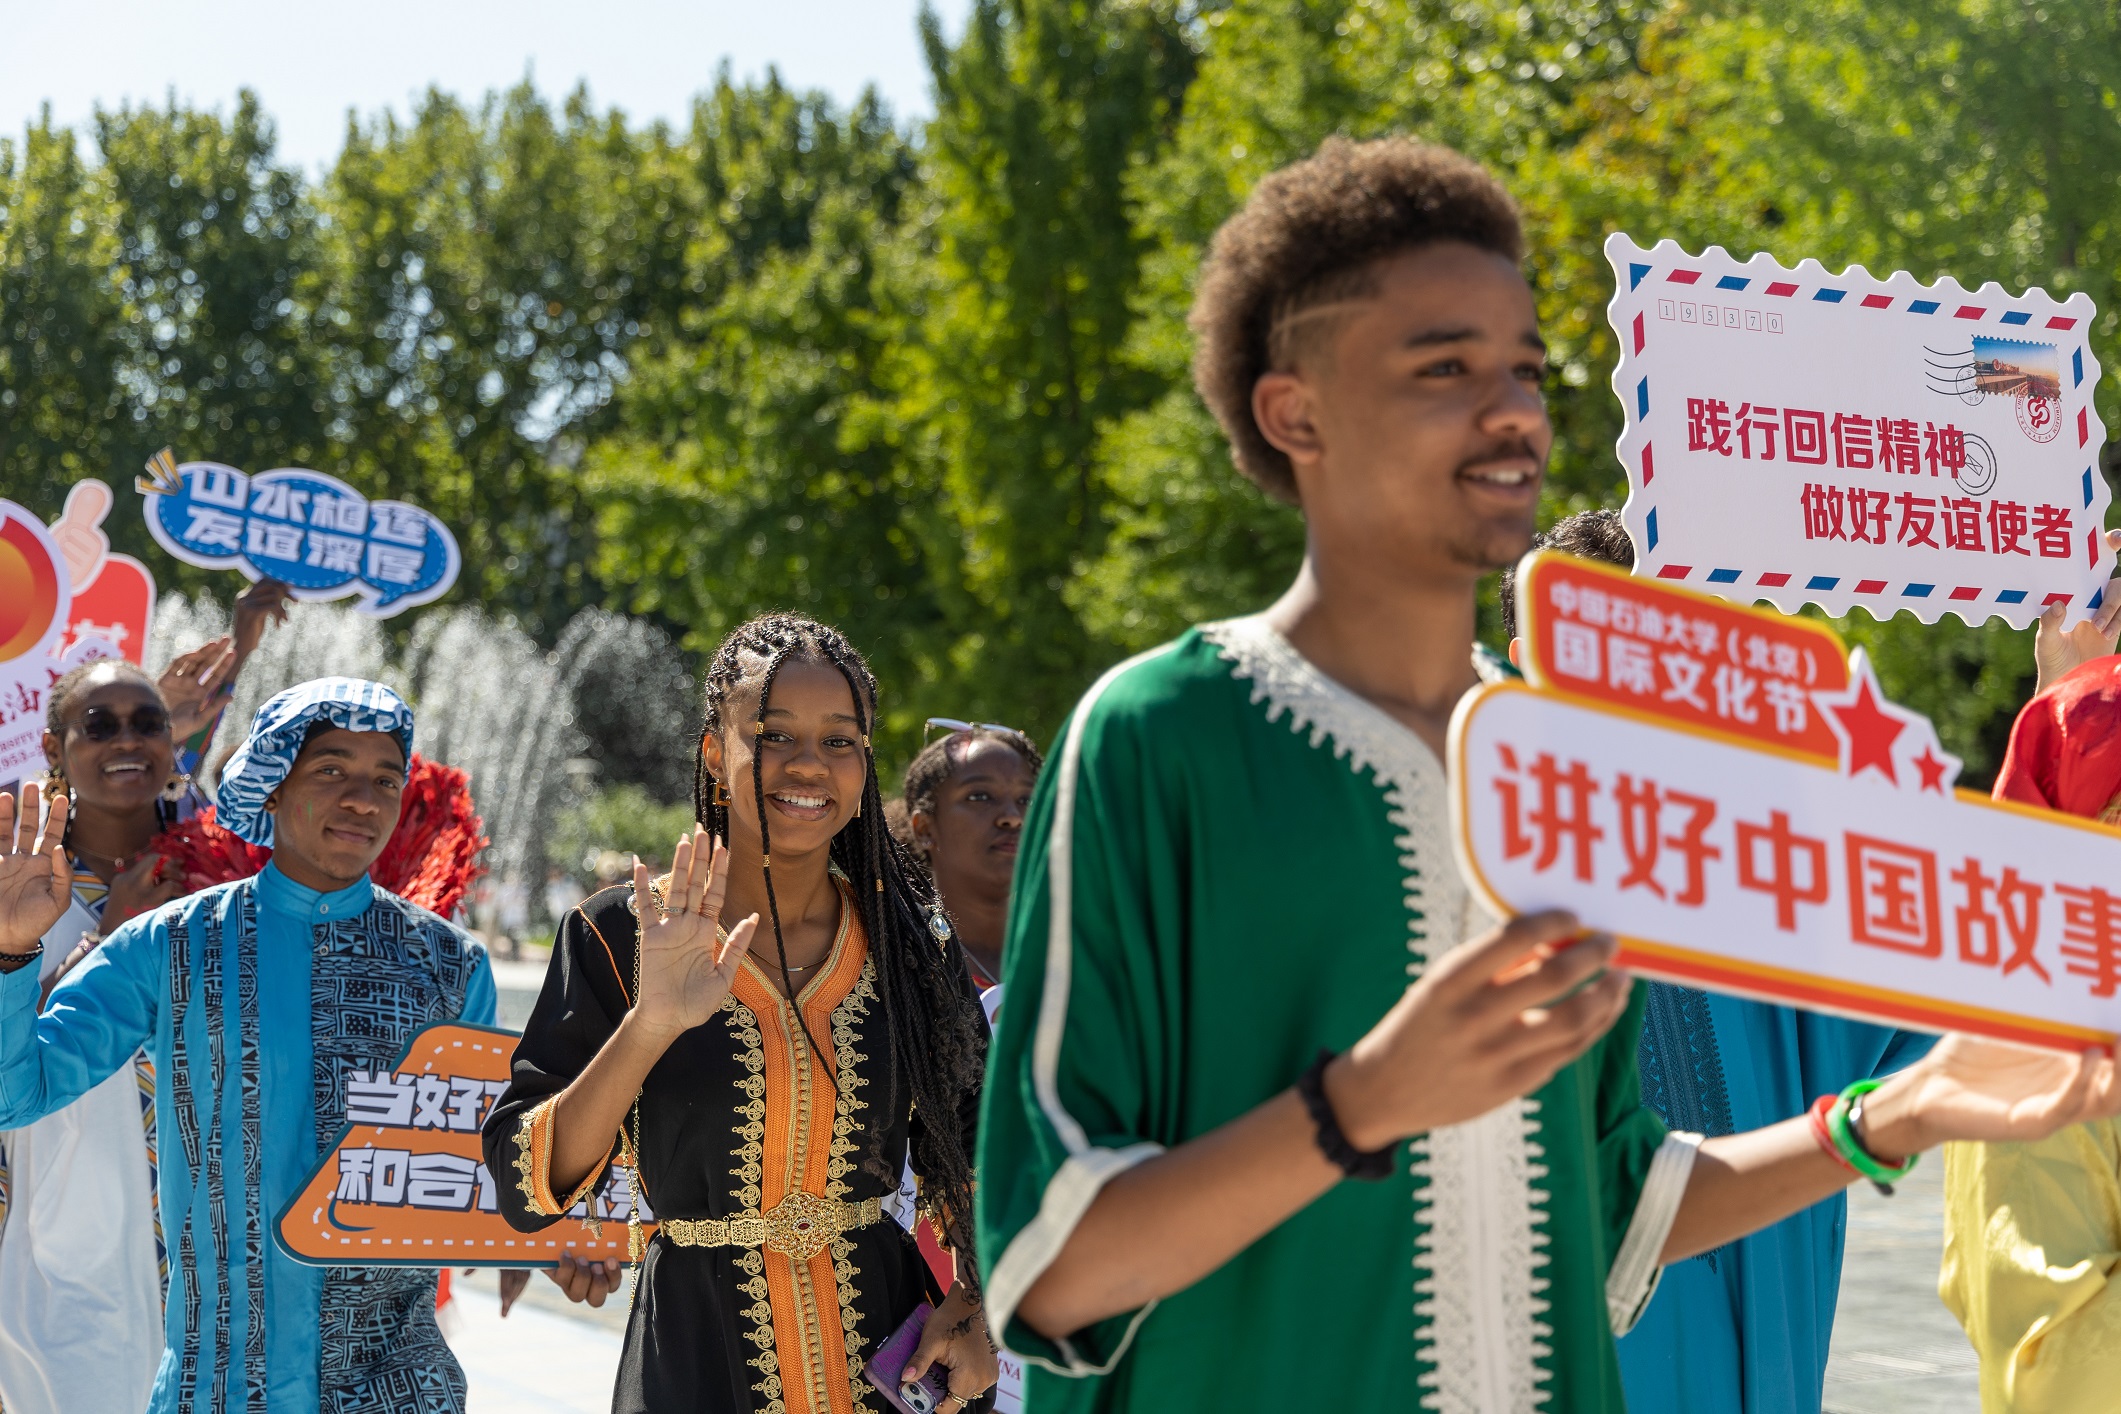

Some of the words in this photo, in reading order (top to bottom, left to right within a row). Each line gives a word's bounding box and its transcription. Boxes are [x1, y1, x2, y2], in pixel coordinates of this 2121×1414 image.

[1687, 398, 1965, 479] 践行回信精神
[183, 504, 425, 585] 友谊深厚
[189, 468, 428, 547] 山水相连
[1800, 483, 2073, 559] 做好友谊使者
[1553, 618, 1808, 733] 国际文化节
[1491, 740, 2121, 999] 讲好中国故事
